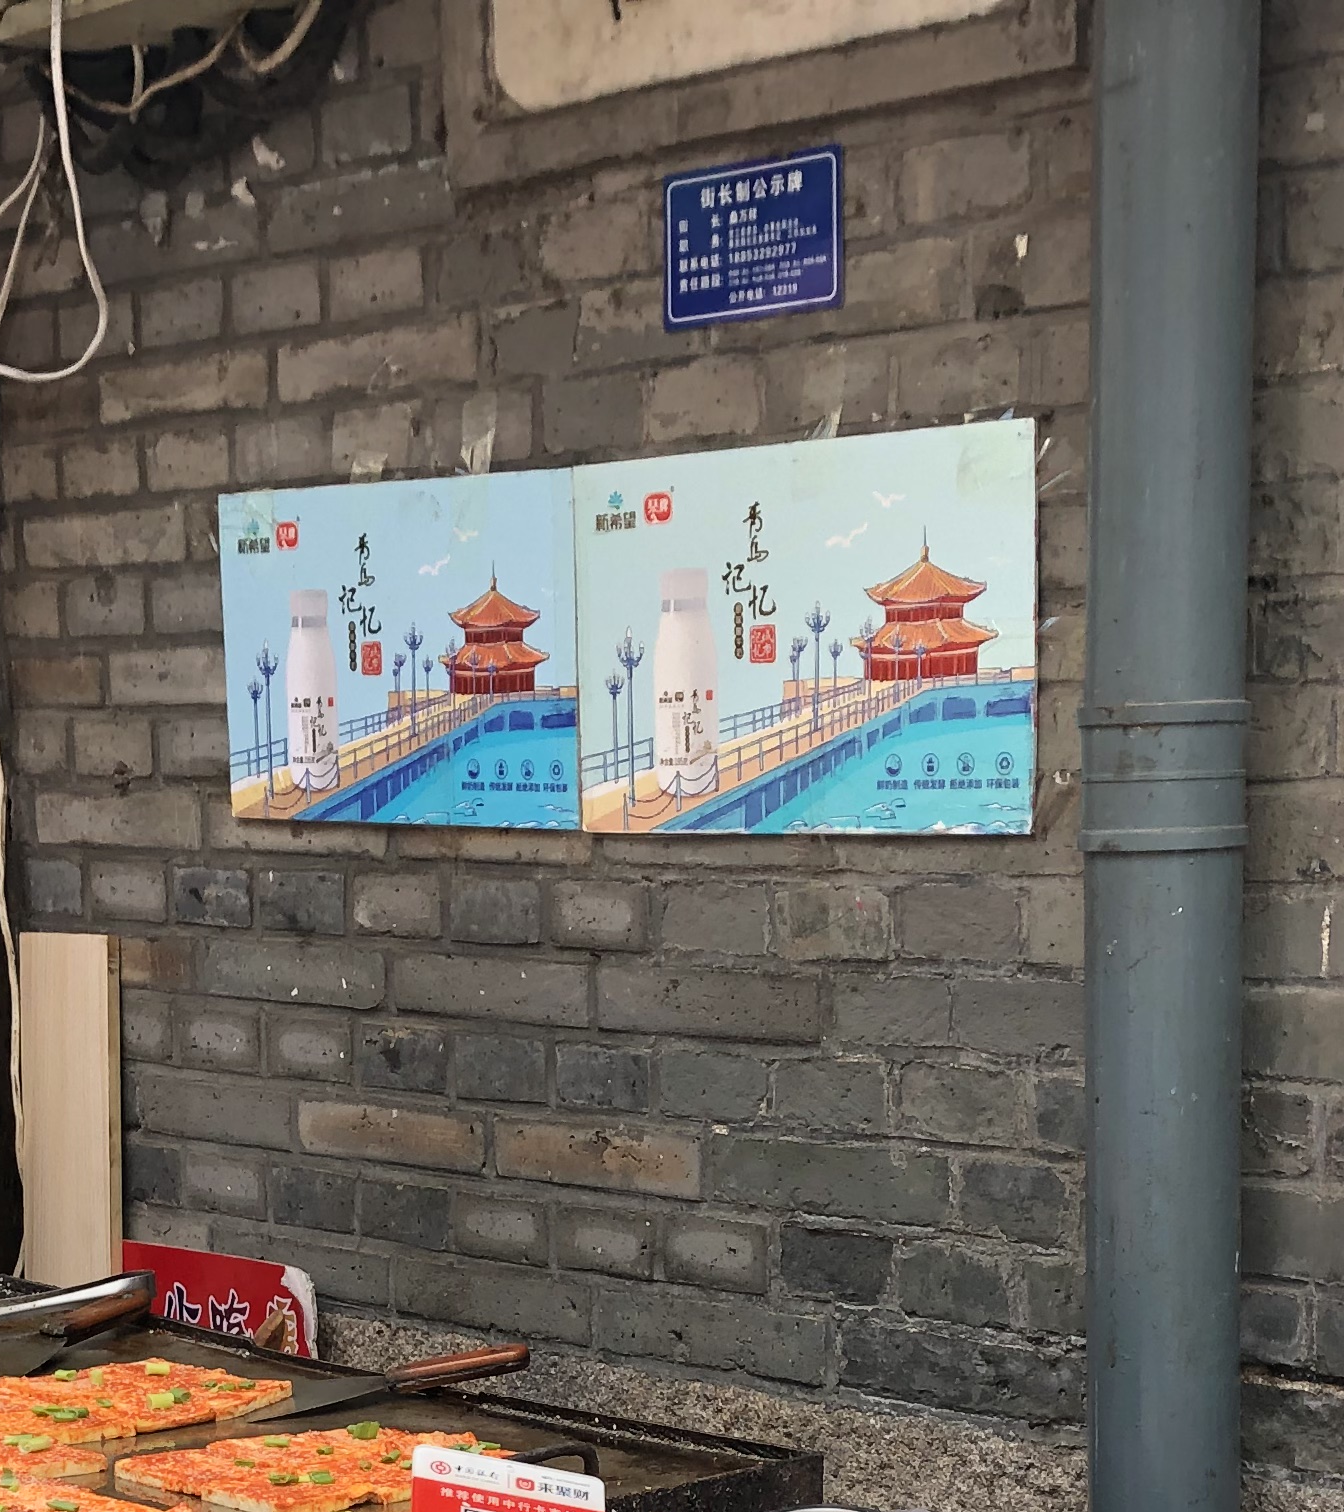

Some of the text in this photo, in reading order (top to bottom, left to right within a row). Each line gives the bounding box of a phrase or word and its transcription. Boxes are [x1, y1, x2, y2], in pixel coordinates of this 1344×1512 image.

[700, 169, 803, 208] 街长制公示牌
[595, 511, 636, 532] 新希望
[237, 537, 270, 554] 新希望
